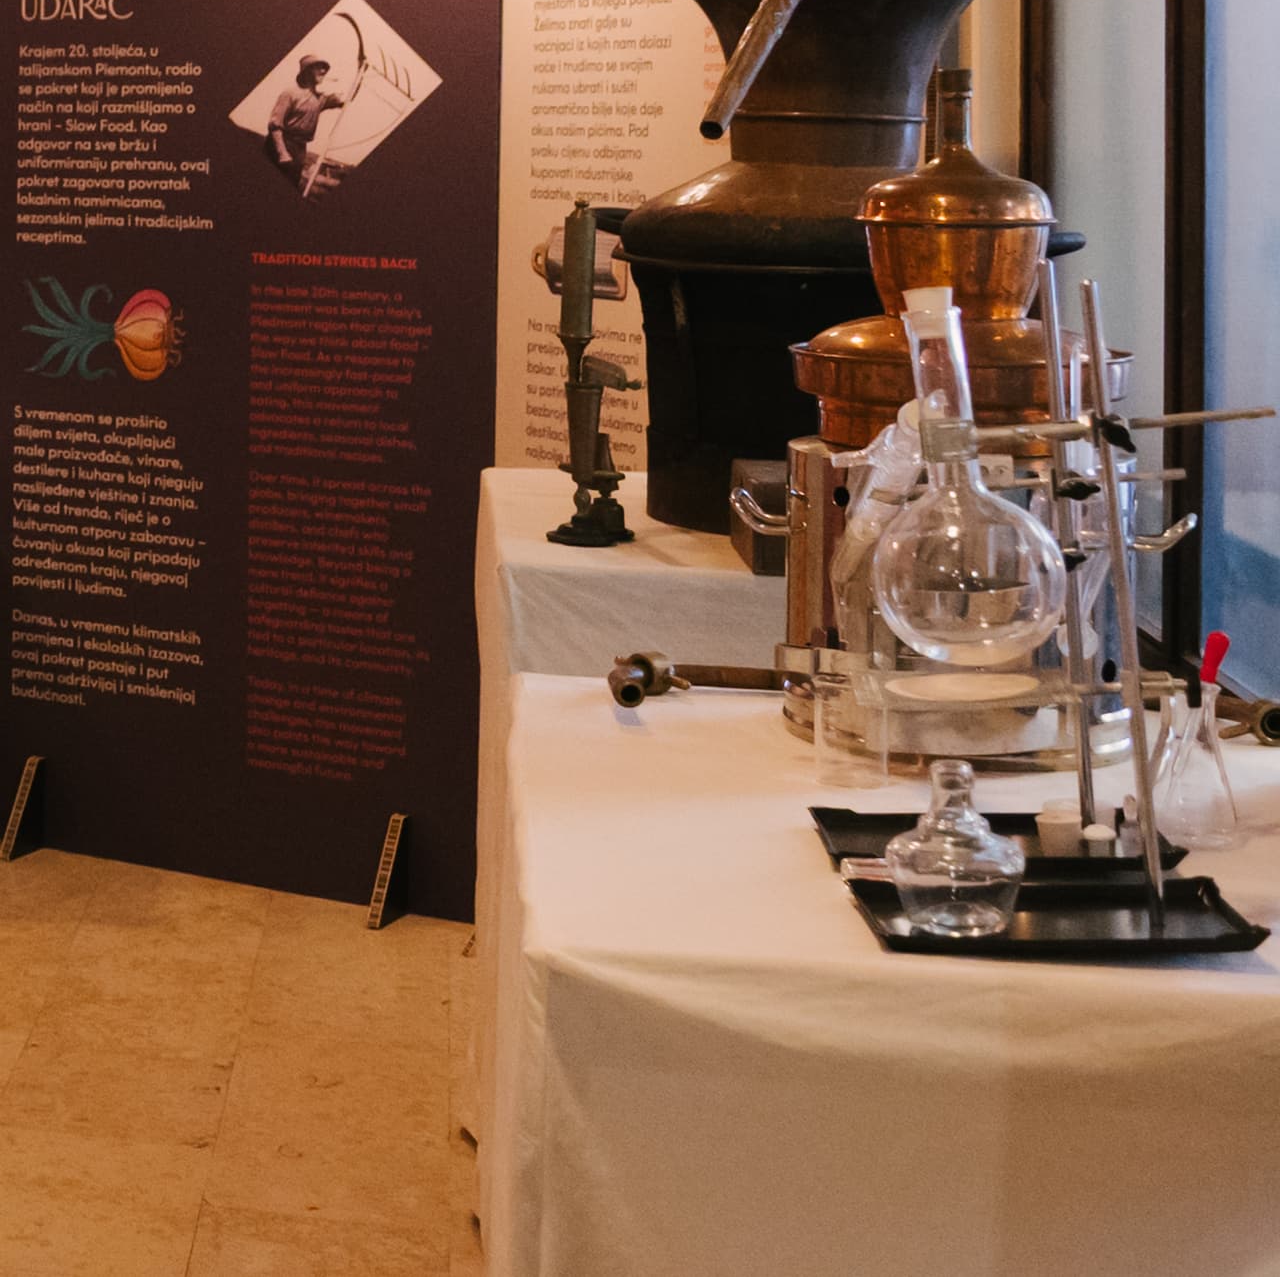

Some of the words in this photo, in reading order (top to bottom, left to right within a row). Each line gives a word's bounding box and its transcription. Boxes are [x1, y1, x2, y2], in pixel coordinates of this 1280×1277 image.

[18, 45, 66, 57] Krajem
[68, 44, 89, 57] 20.
[92, 44, 147, 58] stoljeća,
[149, 48, 159, 58] u
[18, 64, 93, 76] talijanskom
[94, 63, 162, 75] Piemontu,
[165, 63, 203, 75] rodio
[18, 86, 33, 95] se
[34, 83, 79, 95] pokret
[80, 82, 104, 96] koji
[105, 83, 119, 98] je
[120, 82, 194, 96] promijenio
[17, 100, 54, 112] način
[56, 104, 74, 114] na
[75, 100, 99, 114] koji
[101, 101, 184, 114] razmišljamo
[185, 105, 196, 115] o
[17, 119, 52, 131] hrani
[65, 119, 97, 131] Slow
[99, 119, 138, 132] Food.
[140, 120, 168, 132] Kao
[251, 252, 321, 266] TRADITION
[324, 255, 376, 269] STRIKES
[380, 257, 417, 270] BACK
[14, 405, 23, 418] S
[25, 410, 95, 422] vremenom
[97, 415, 113, 426] se
[115, 416, 168, 428] proširio
[13, 425, 53, 438] diljem
[55, 429, 101, 443] svijeta,
[103, 433, 176, 449] okupljajući
[13, 444, 46, 457] male
[47, 448, 134, 464] proizvođače,
[136, 455, 183, 469] vinare,
